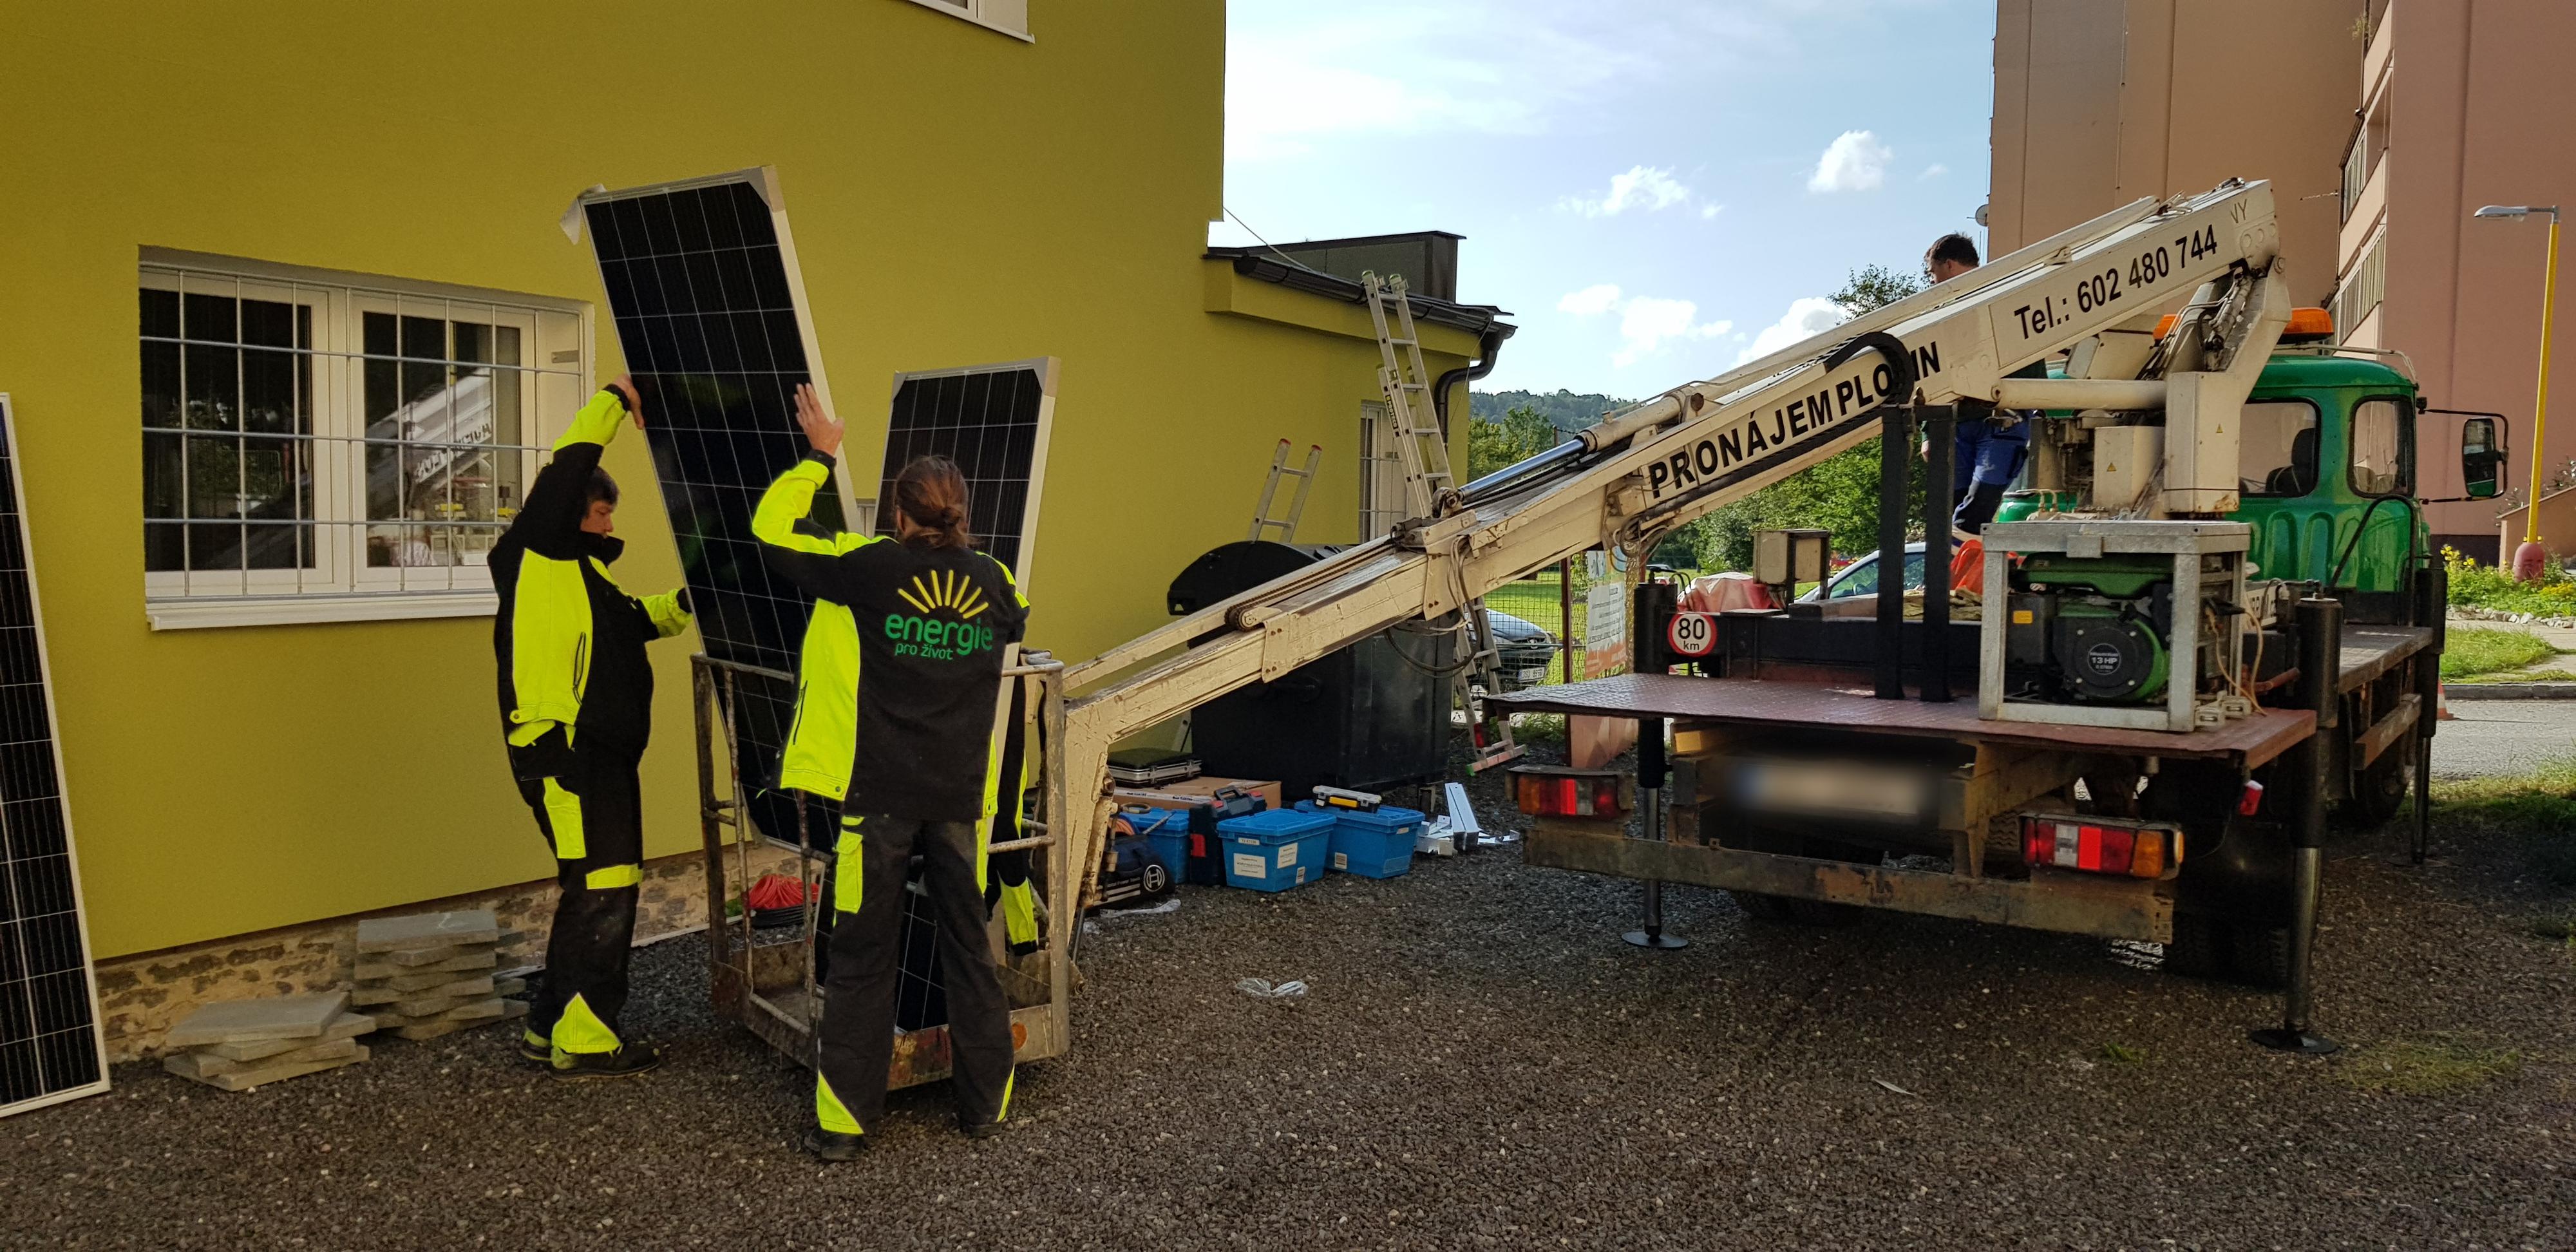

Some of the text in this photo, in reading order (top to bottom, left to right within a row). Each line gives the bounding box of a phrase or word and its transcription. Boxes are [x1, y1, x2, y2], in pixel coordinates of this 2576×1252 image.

[2014, 224, 2217, 340] Tel.: 602 480 744
[1648, 341, 1940, 499] PRONÁJEM PLOIN
[885, 614, 993, 656] energie
[1678, 618, 1705, 640] 80
[895, 643, 954, 660] pro život
[1683, 641, 1700, 650] km
